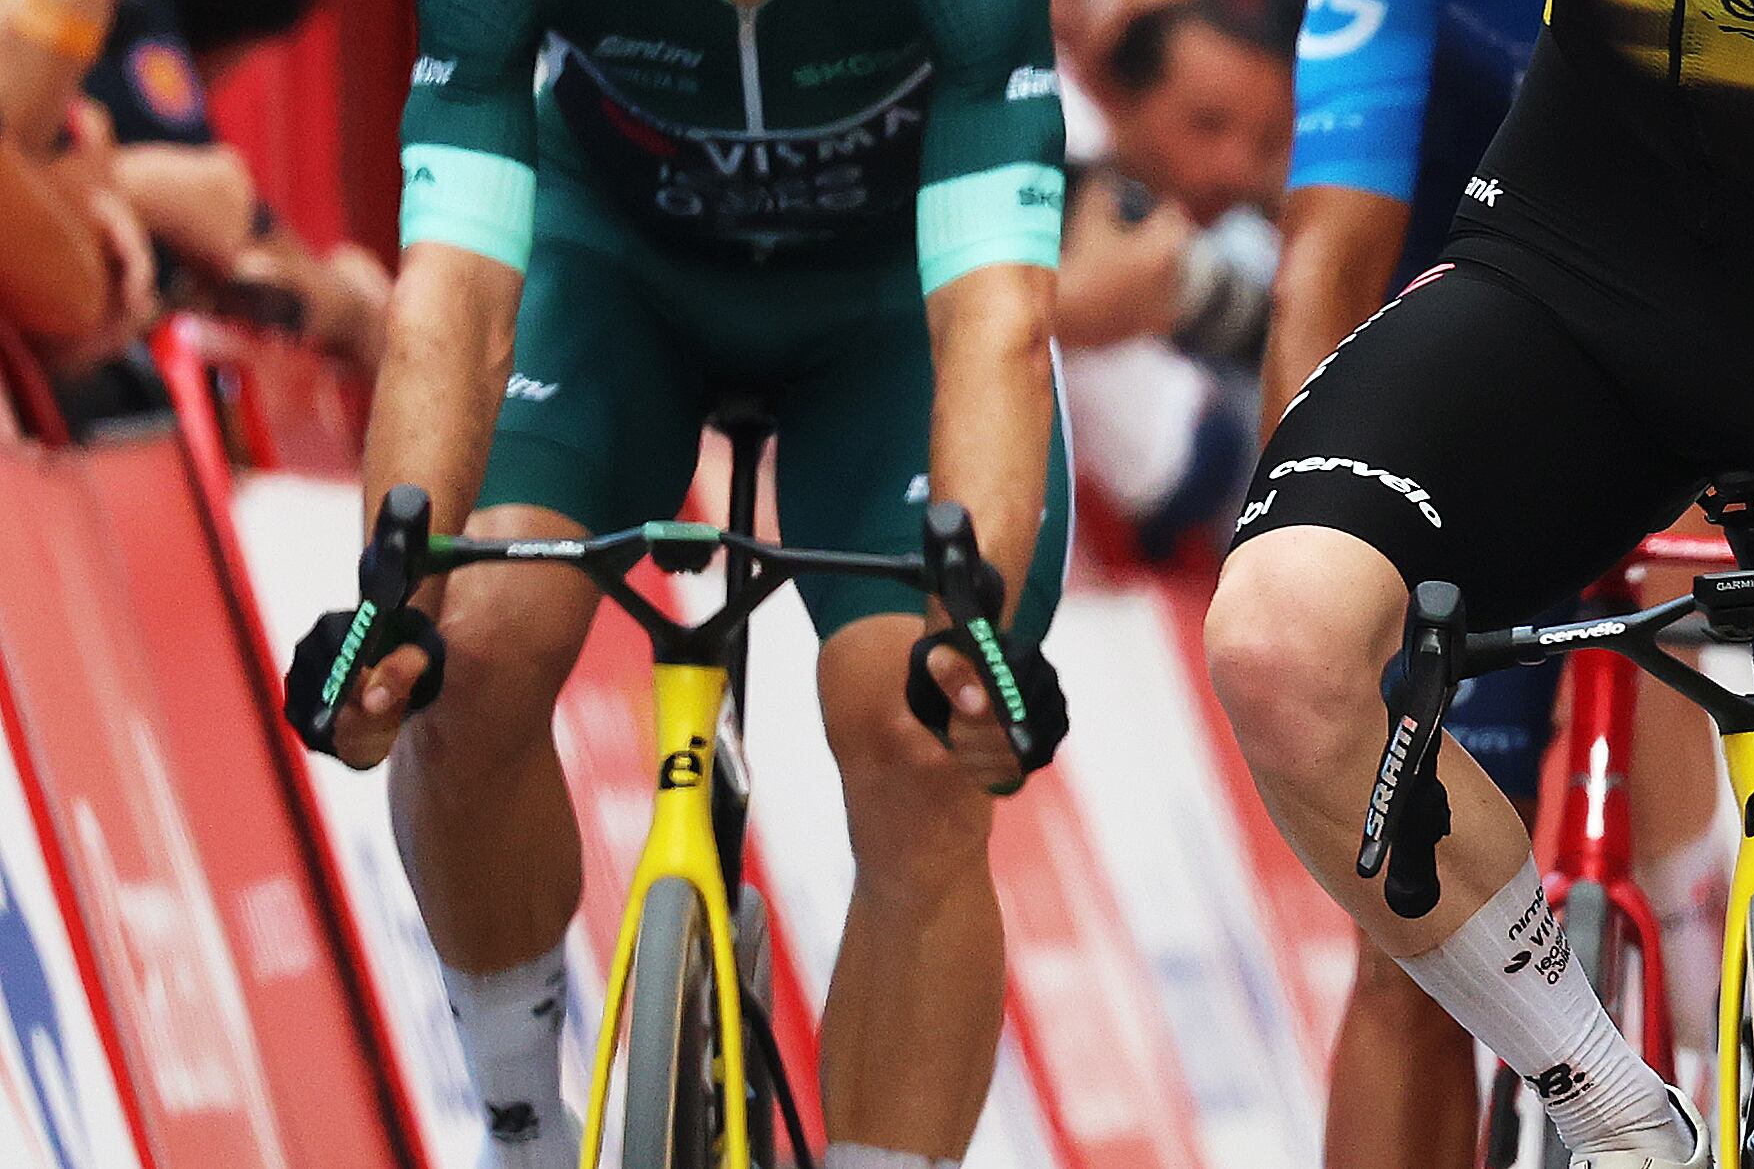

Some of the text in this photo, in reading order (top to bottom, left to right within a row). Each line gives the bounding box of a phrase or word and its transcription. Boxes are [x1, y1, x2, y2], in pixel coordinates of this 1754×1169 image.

[1269, 456, 1442, 529] cervélo
[322, 599, 378, 708] SRAM
[967, 617, 1028, 722] SRAM
[1539, 621, 1626, 645] cervélo
[1365, 715, 1420, 841] SRAM
